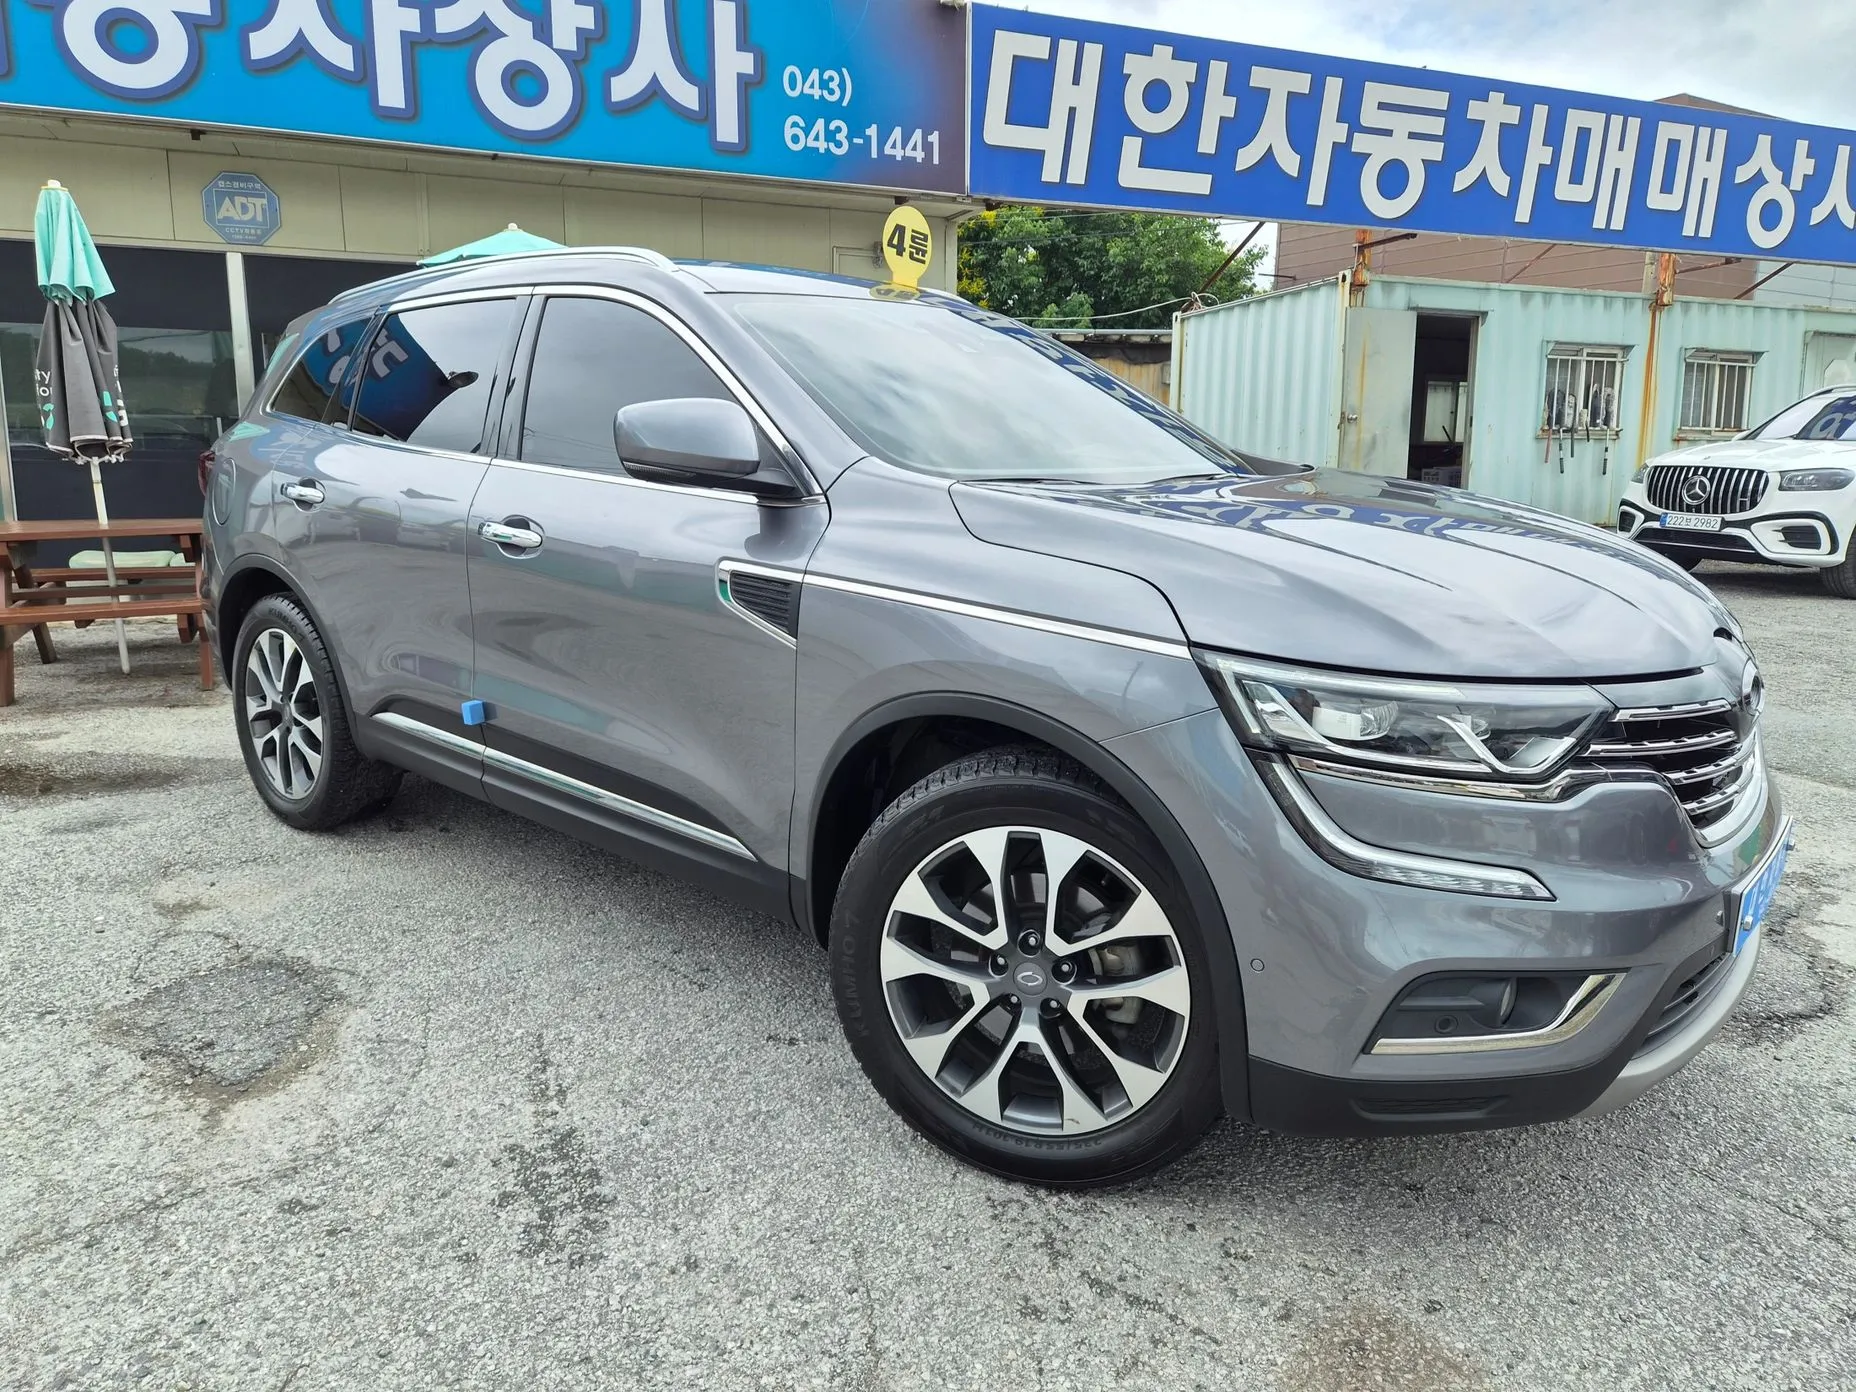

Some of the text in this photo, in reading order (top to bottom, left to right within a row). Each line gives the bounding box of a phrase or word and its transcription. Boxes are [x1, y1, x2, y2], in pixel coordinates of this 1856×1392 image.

[782, 64, 852, 107] 043)
[783, 115, 940, 165] 643-1441
[217, 196, 267, 221] ADT
[887, 223, 929, 265] 4륜
[1693, 516, 1719, 529] 2982
[841, 935, 871, 1038] KUMHO
